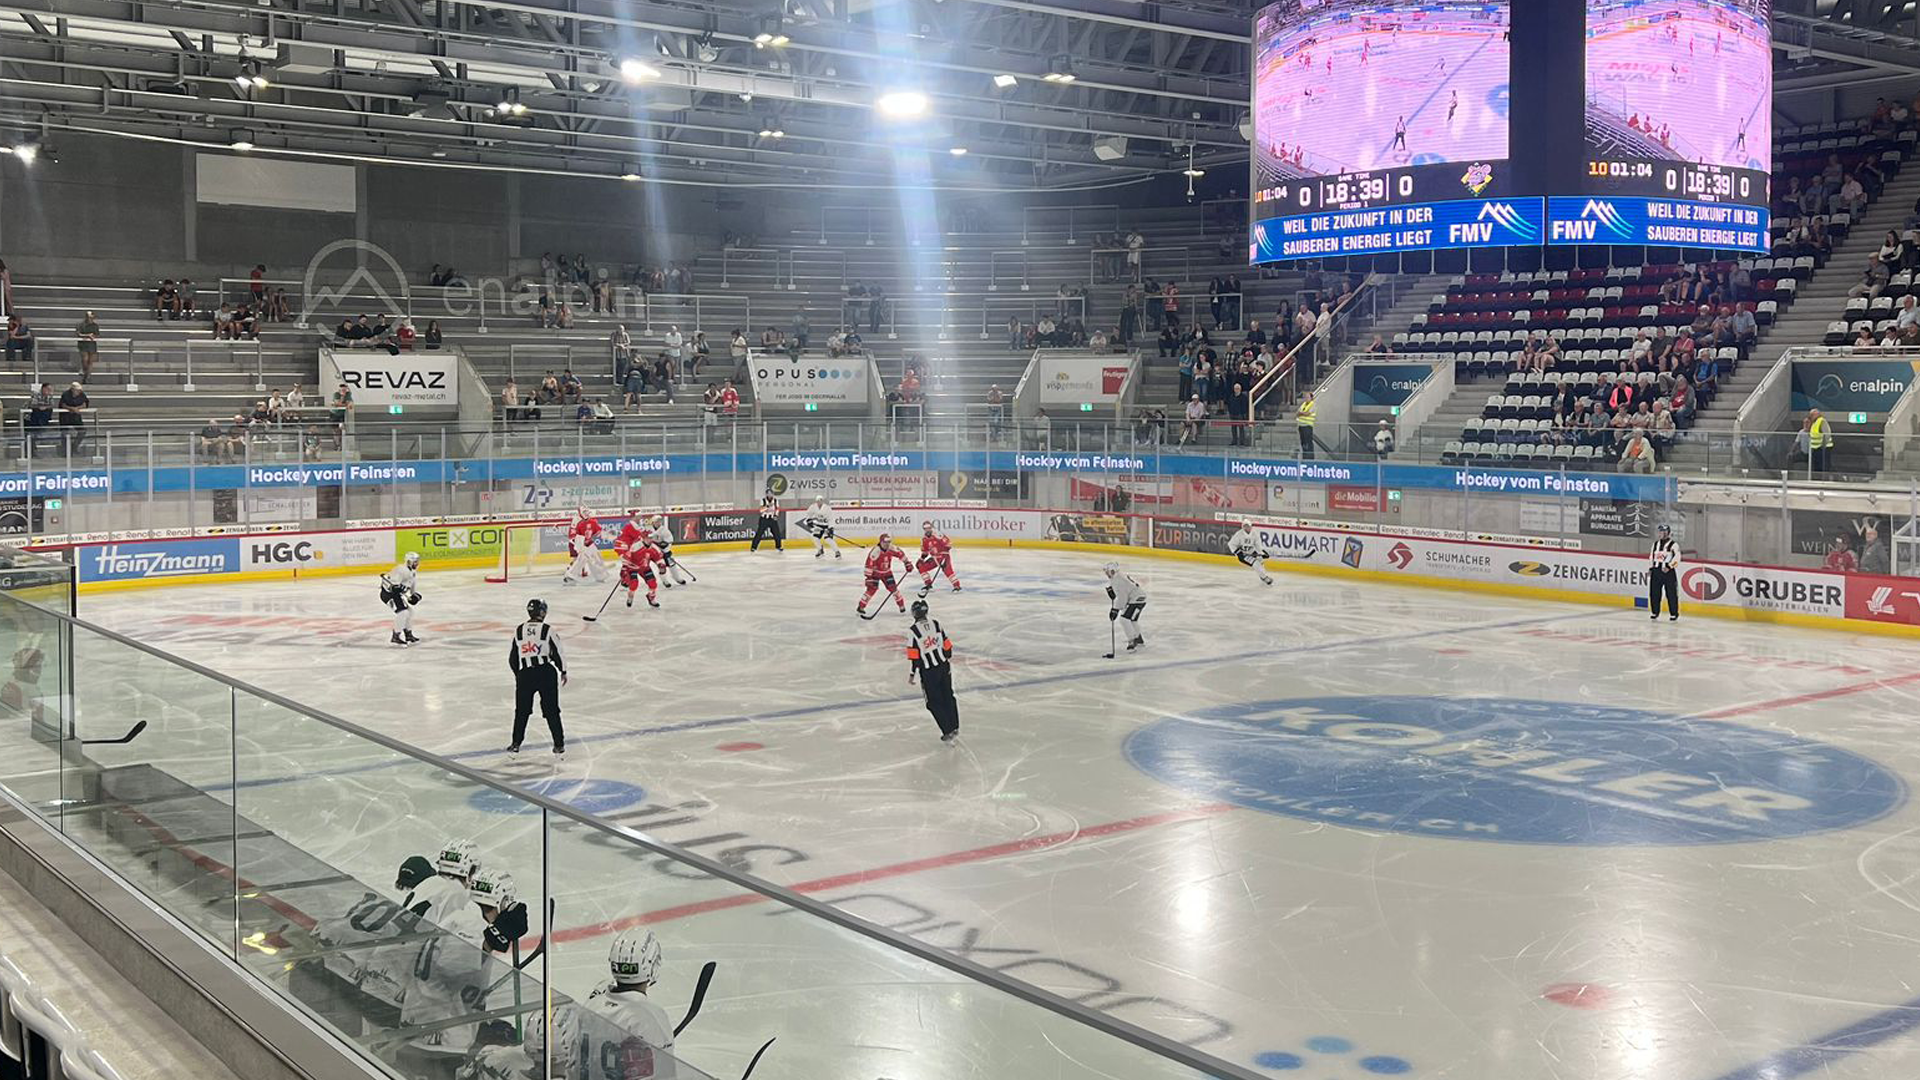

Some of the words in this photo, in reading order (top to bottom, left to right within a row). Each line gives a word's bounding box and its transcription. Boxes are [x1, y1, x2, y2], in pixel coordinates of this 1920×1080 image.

[1589, 162, 1608, 175] 10
[1610, 163, 1653, 177] 01:04
[1399, 176, 1413, 196] 0
[1666, 170, 1677, 189] 0
[1688, 172, 1730, 195] 18:39
[1740, 177, 1749, 197] 0
[1300, 187, 1311, 206] 0
[1326, 178, 1384, 203] 18:39
[1283, 219, 1308, 234] WEIL
[1311, 216, 1330, 232] DIE
[1334, 210, 1385, 230] ZUKUNFT
[1390, 211, 1402, 226] IN
[1407, 207, 1433, 223] DER
[1648, 202, 1674, 219] WEIL
[1676, 204, 1692, 219] DIE
[1693, 205, 1731, 223] ZUKUNFT
[1734, 208, 1743, 223] IN
[1744, 209, 1758, 225] DER
[1450, 223, 1493, 243] FMV
[1553, 220, 1597, 239] FMV
[1648, 225, 1698, 243] SAUBEREN
[1700, 228, 1736, 245] ENERGIE
[1738, 231, 1758, 246] LIEGT
[1283, 236, 1339, 255] SAUBEREN
[1343, 233, 1391, 251] ENERGIE
[1396, 229, 1433, 246] LIEGT
[343, 371, 446, 389] REVAZ
[757, 369, 816, 379] OPUS
[1850, 378, 1904, 395] enalpin
[391, 391, 446, 401] revaz-metal.ch
[534, 461, 582, 475] Hockey
[586, 462, 613, 472] vom
[616, 458, 670, 471] Feinsten
[772, 455, 819, 467] Hockey
[822, 456, 849, 466] vom
[852, 455, 908, 466] Feinsten
[1015, 455, 1062, 469] Hockey
[1231, 461, 1272, 477] Hockey
[1274, 465, 1298, 477] vom
[1300, 464, 1350, 479] Feinsten
[251, 468, 310, 483] Hockey
[350, 466, 416, 480] Feinsten
[1456, 472, 1509, 490] Hockey
[1510, 477, 1540, 490] vom
[1544, 475, 1609, 493] Feinsten
[705, 517, 744, 526] Walliser
[863, 516, 897, 524] Bautech
[899, 516, 911, 524] AG
[932, 515, 1026, 537] qualibroker
[1260, 531, 1338, 553] RAUMART
[1412, 529, 1440, 537] Renotec
[252, 541, 312, 563] HGC
[1426, 551, 1490, 566] SCHUMACHER
[1553, 564, 1648, 586] ZENGAFFINEN
[1749, 600, 1829, 613] BAUMATERIALIEN
[527, 628, 536, 636] 54
[521, 641, 543, 655] sky
